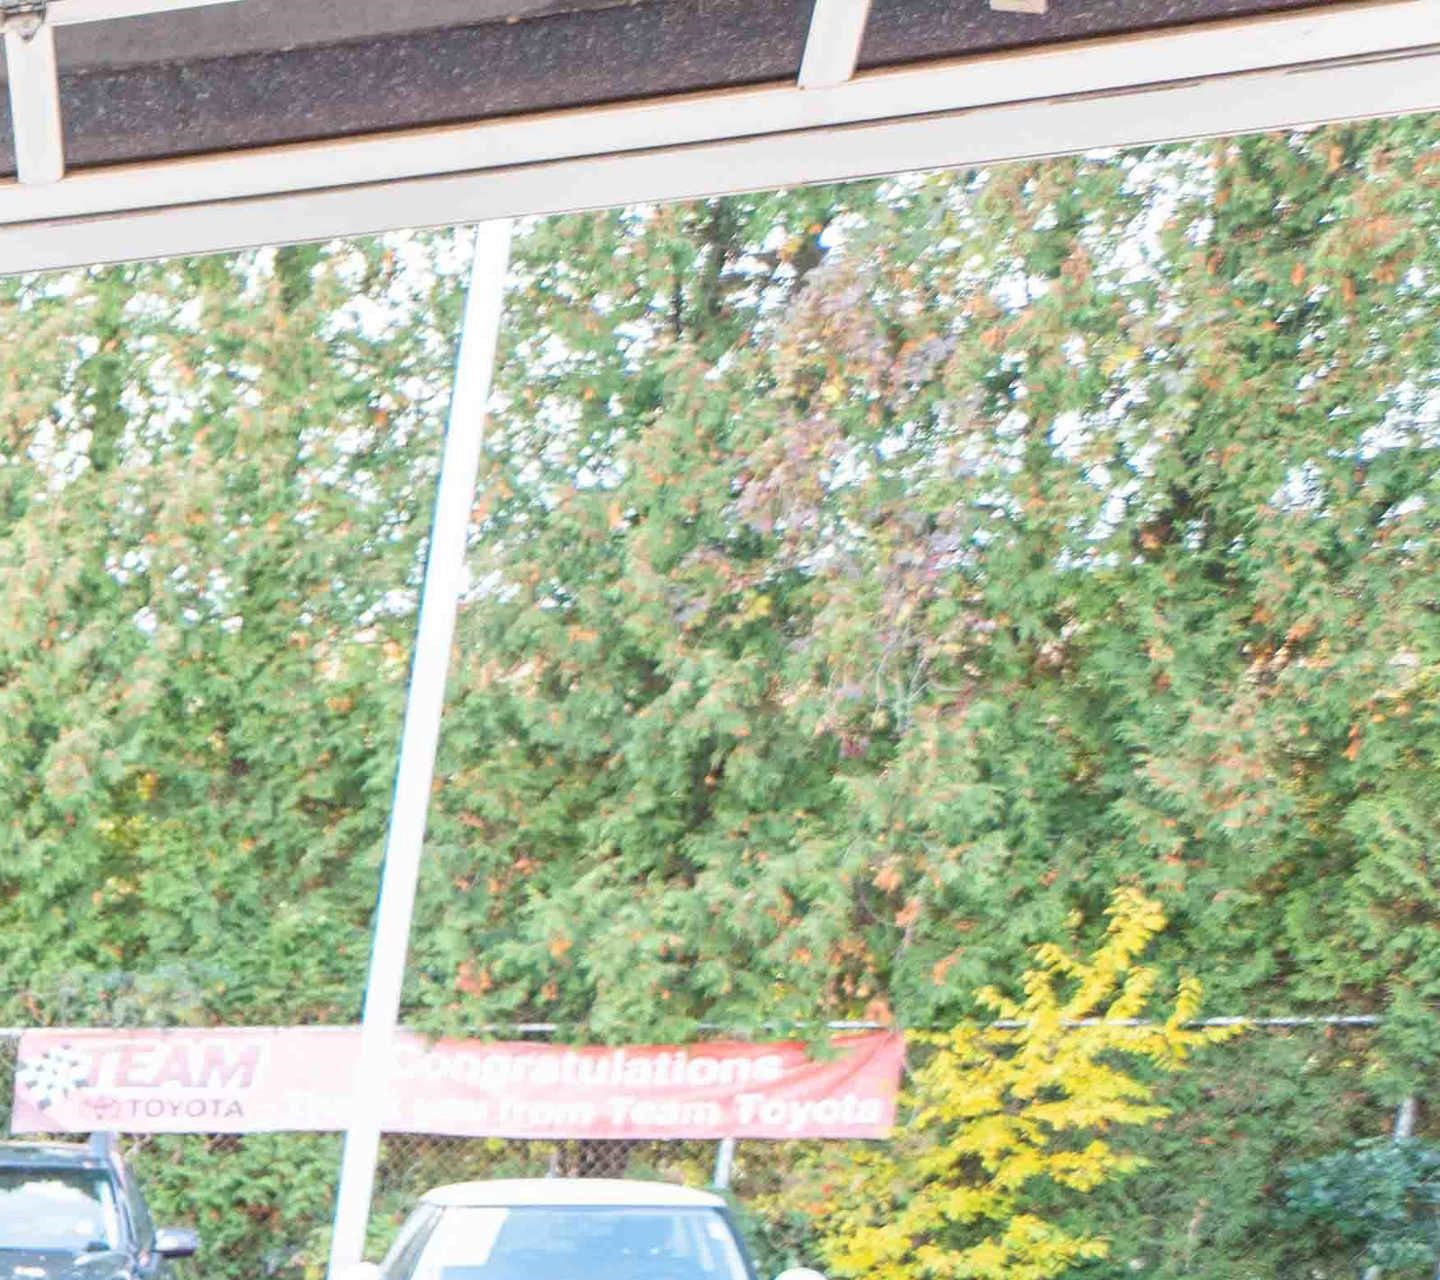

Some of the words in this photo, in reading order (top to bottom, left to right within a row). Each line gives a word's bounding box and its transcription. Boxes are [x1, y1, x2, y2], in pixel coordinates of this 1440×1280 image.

[80, 1045, 261, 1090] TEAM
[391, 1042, 779, 1096] Congratulations
[131, 1099, 245, 1119] TOYOTA
[611, 1097, 720, 1127] Team
[736, 1093, 881, 1132] Toyota
